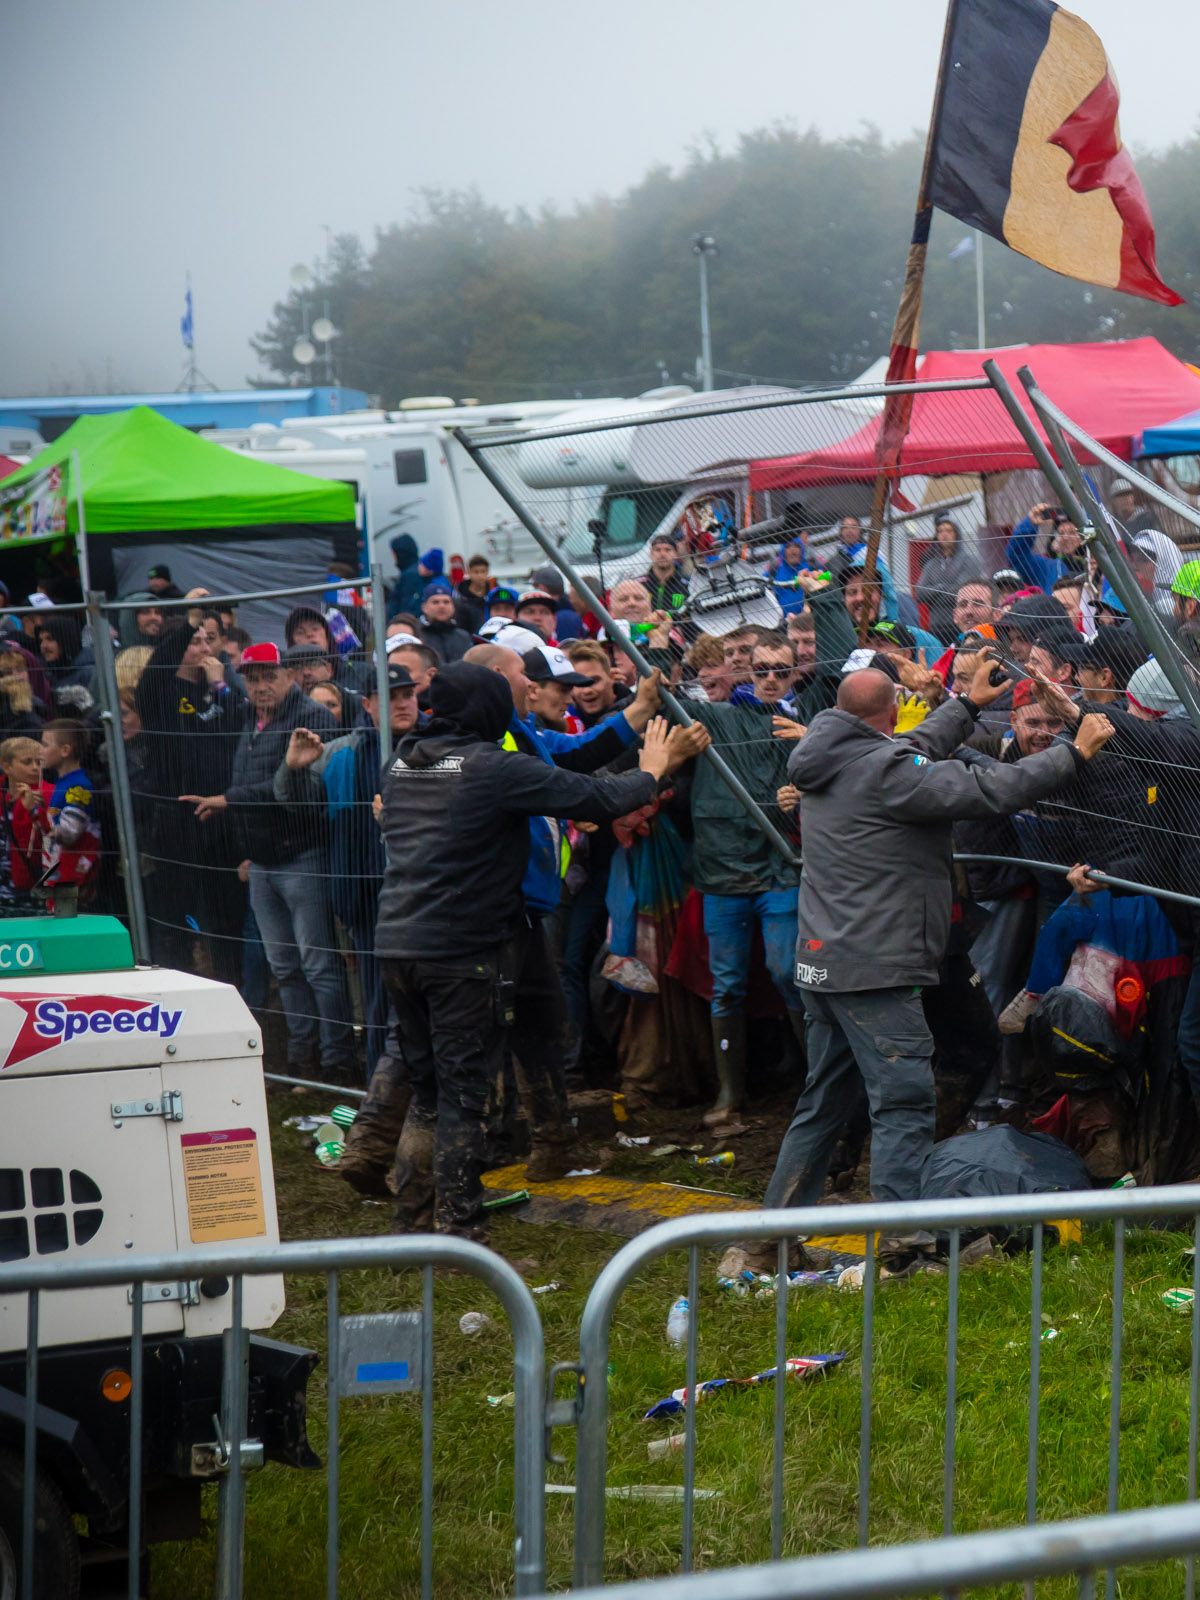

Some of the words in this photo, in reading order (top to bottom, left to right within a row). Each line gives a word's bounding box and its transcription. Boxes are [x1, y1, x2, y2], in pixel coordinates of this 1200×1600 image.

[797, 962, 813, 984] FOX
[34, 1001, 184, 1041] Speedy
[184, 1147, 223, 1155] ENVIRONMENTAL
[224, 1143, 254, 1151] PROTECTION
